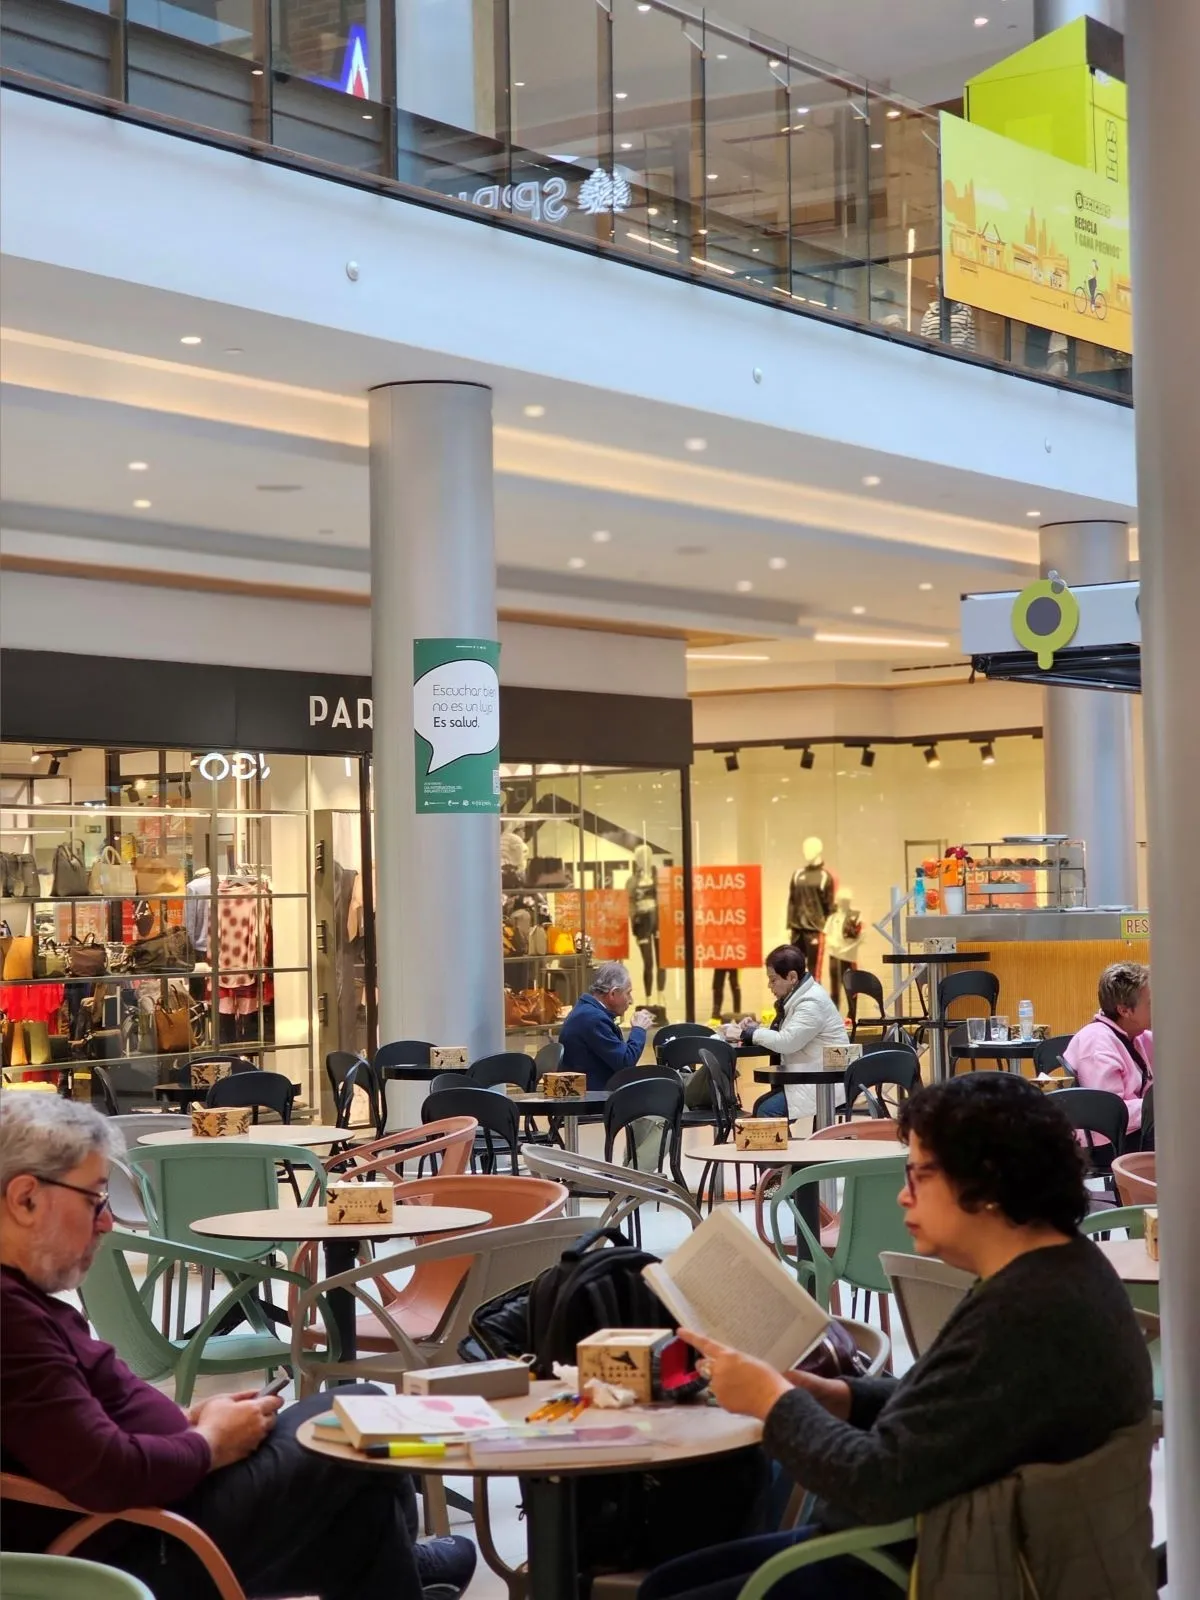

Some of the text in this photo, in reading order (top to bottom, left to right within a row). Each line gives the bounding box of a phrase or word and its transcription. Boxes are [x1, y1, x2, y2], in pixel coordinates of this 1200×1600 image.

[432, 684, 482, 697] Escuchar
[432, 702, 448, 712] no
[450, 702, 463, 712] es
[465, 703, 478, 712] un
[433, 715, 480, 729] Es salud.
[674, 872, 746, 891] RBAJAS
[674, 908, 747, 926] RBAJAS
[675, 944, 747, 961] RBAJAS
